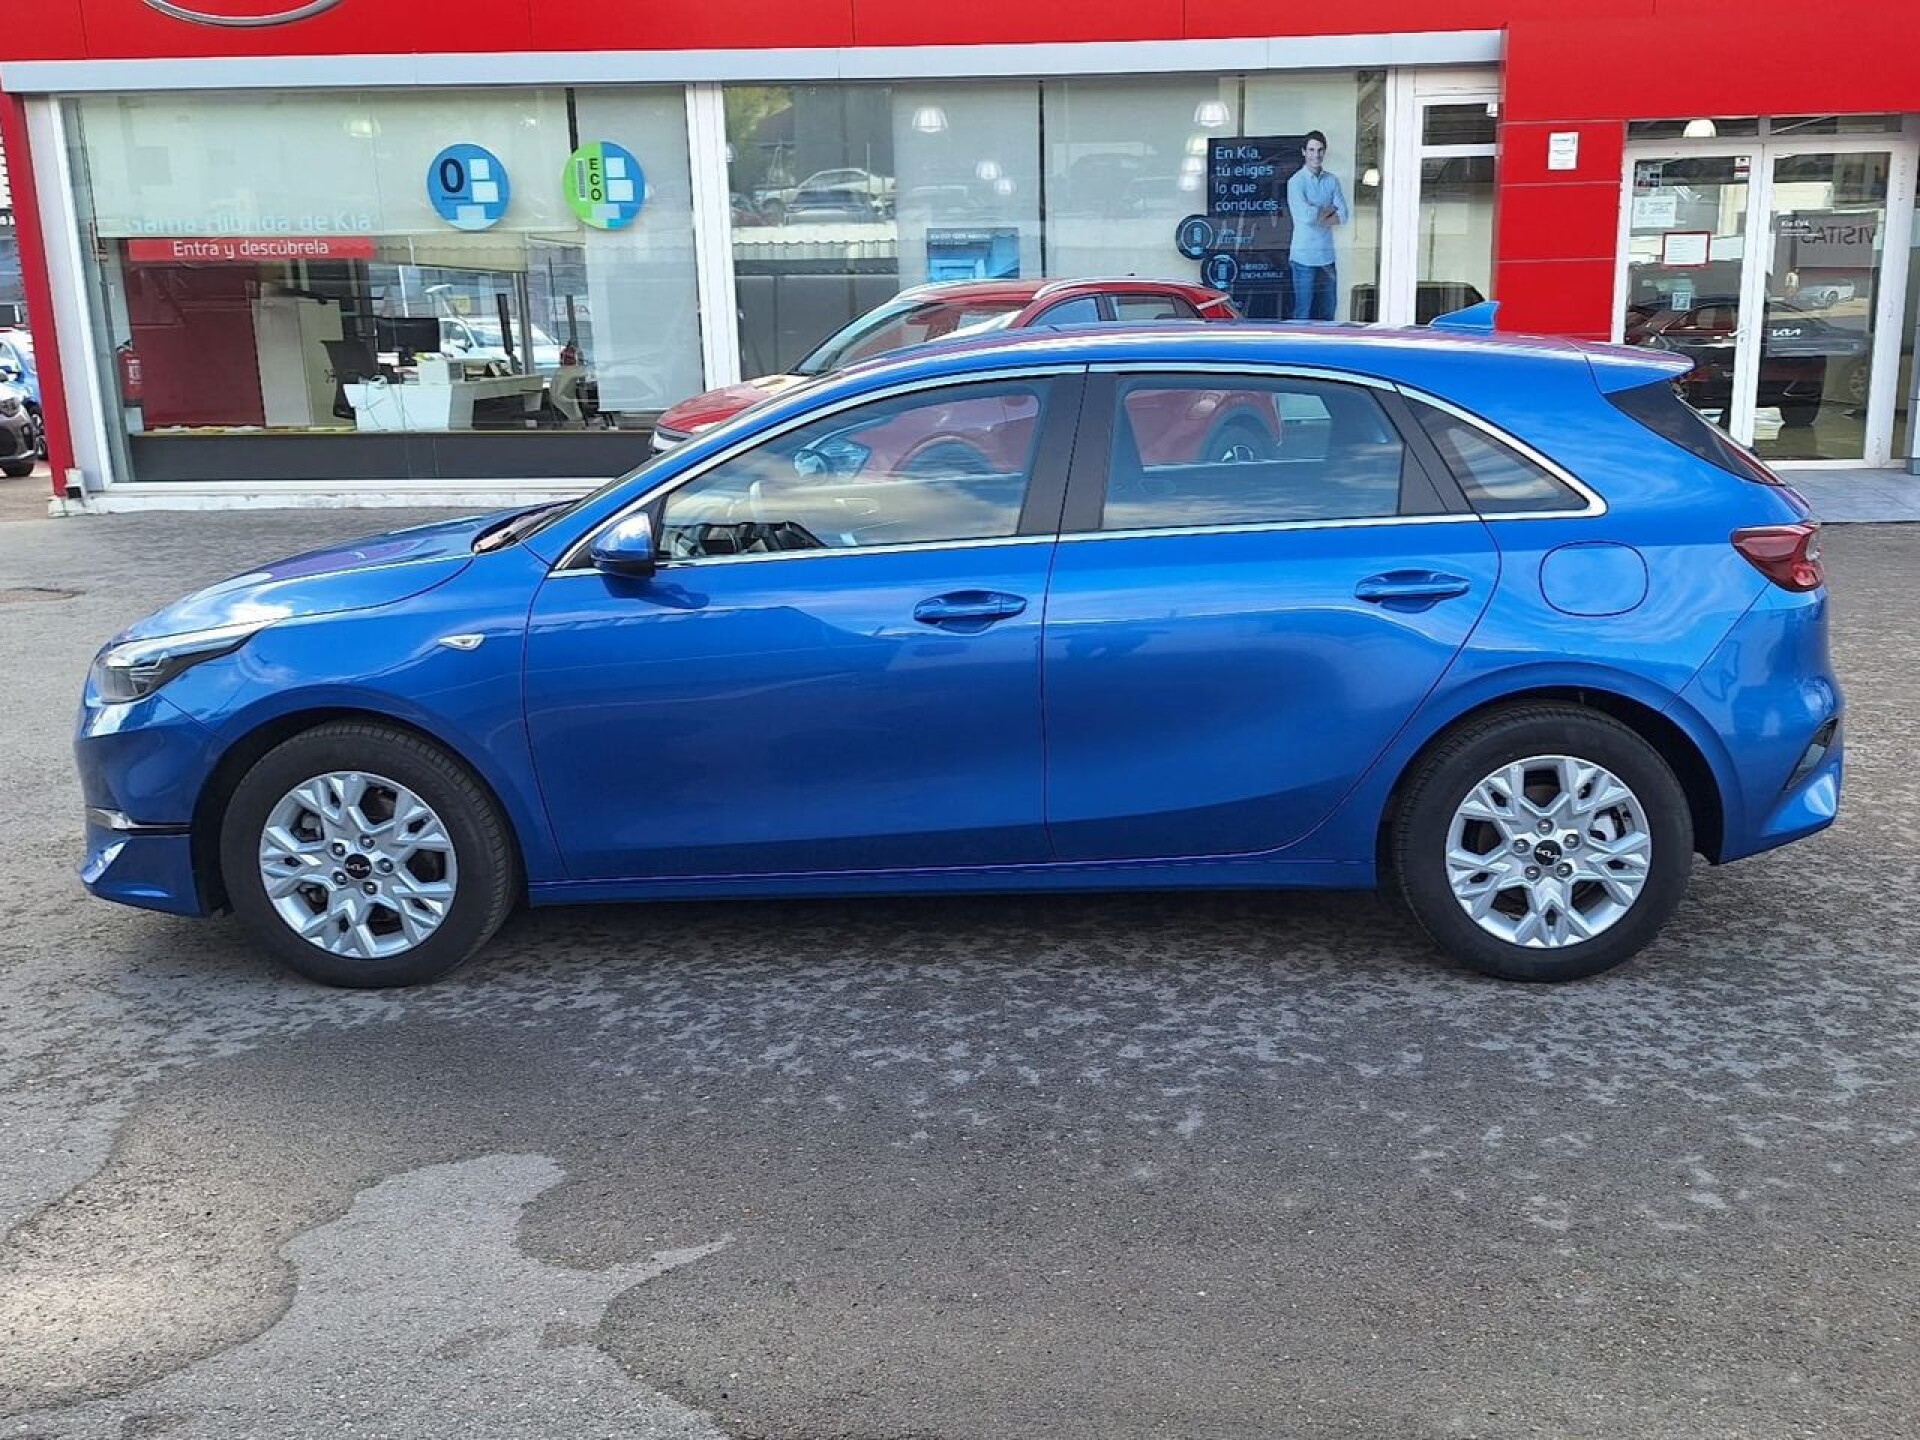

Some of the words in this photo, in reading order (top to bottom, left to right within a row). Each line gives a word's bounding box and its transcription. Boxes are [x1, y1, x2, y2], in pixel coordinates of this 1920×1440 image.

[1215, 146, 1234, 160] En
[440, 158, 465, 193] 0
[588, 157, 602, 201] ECO
[1215, 163, 1231, 177] tú
[1235, 164, 1274, 179] eliges
[1215, 182, 1228, 194] lo
[1231, 184, 1257, 196] que
[173, 240, 220, 256] Entra
[225, 243, 235, 258] y
[239, 239, 329, 256] descúbrela
